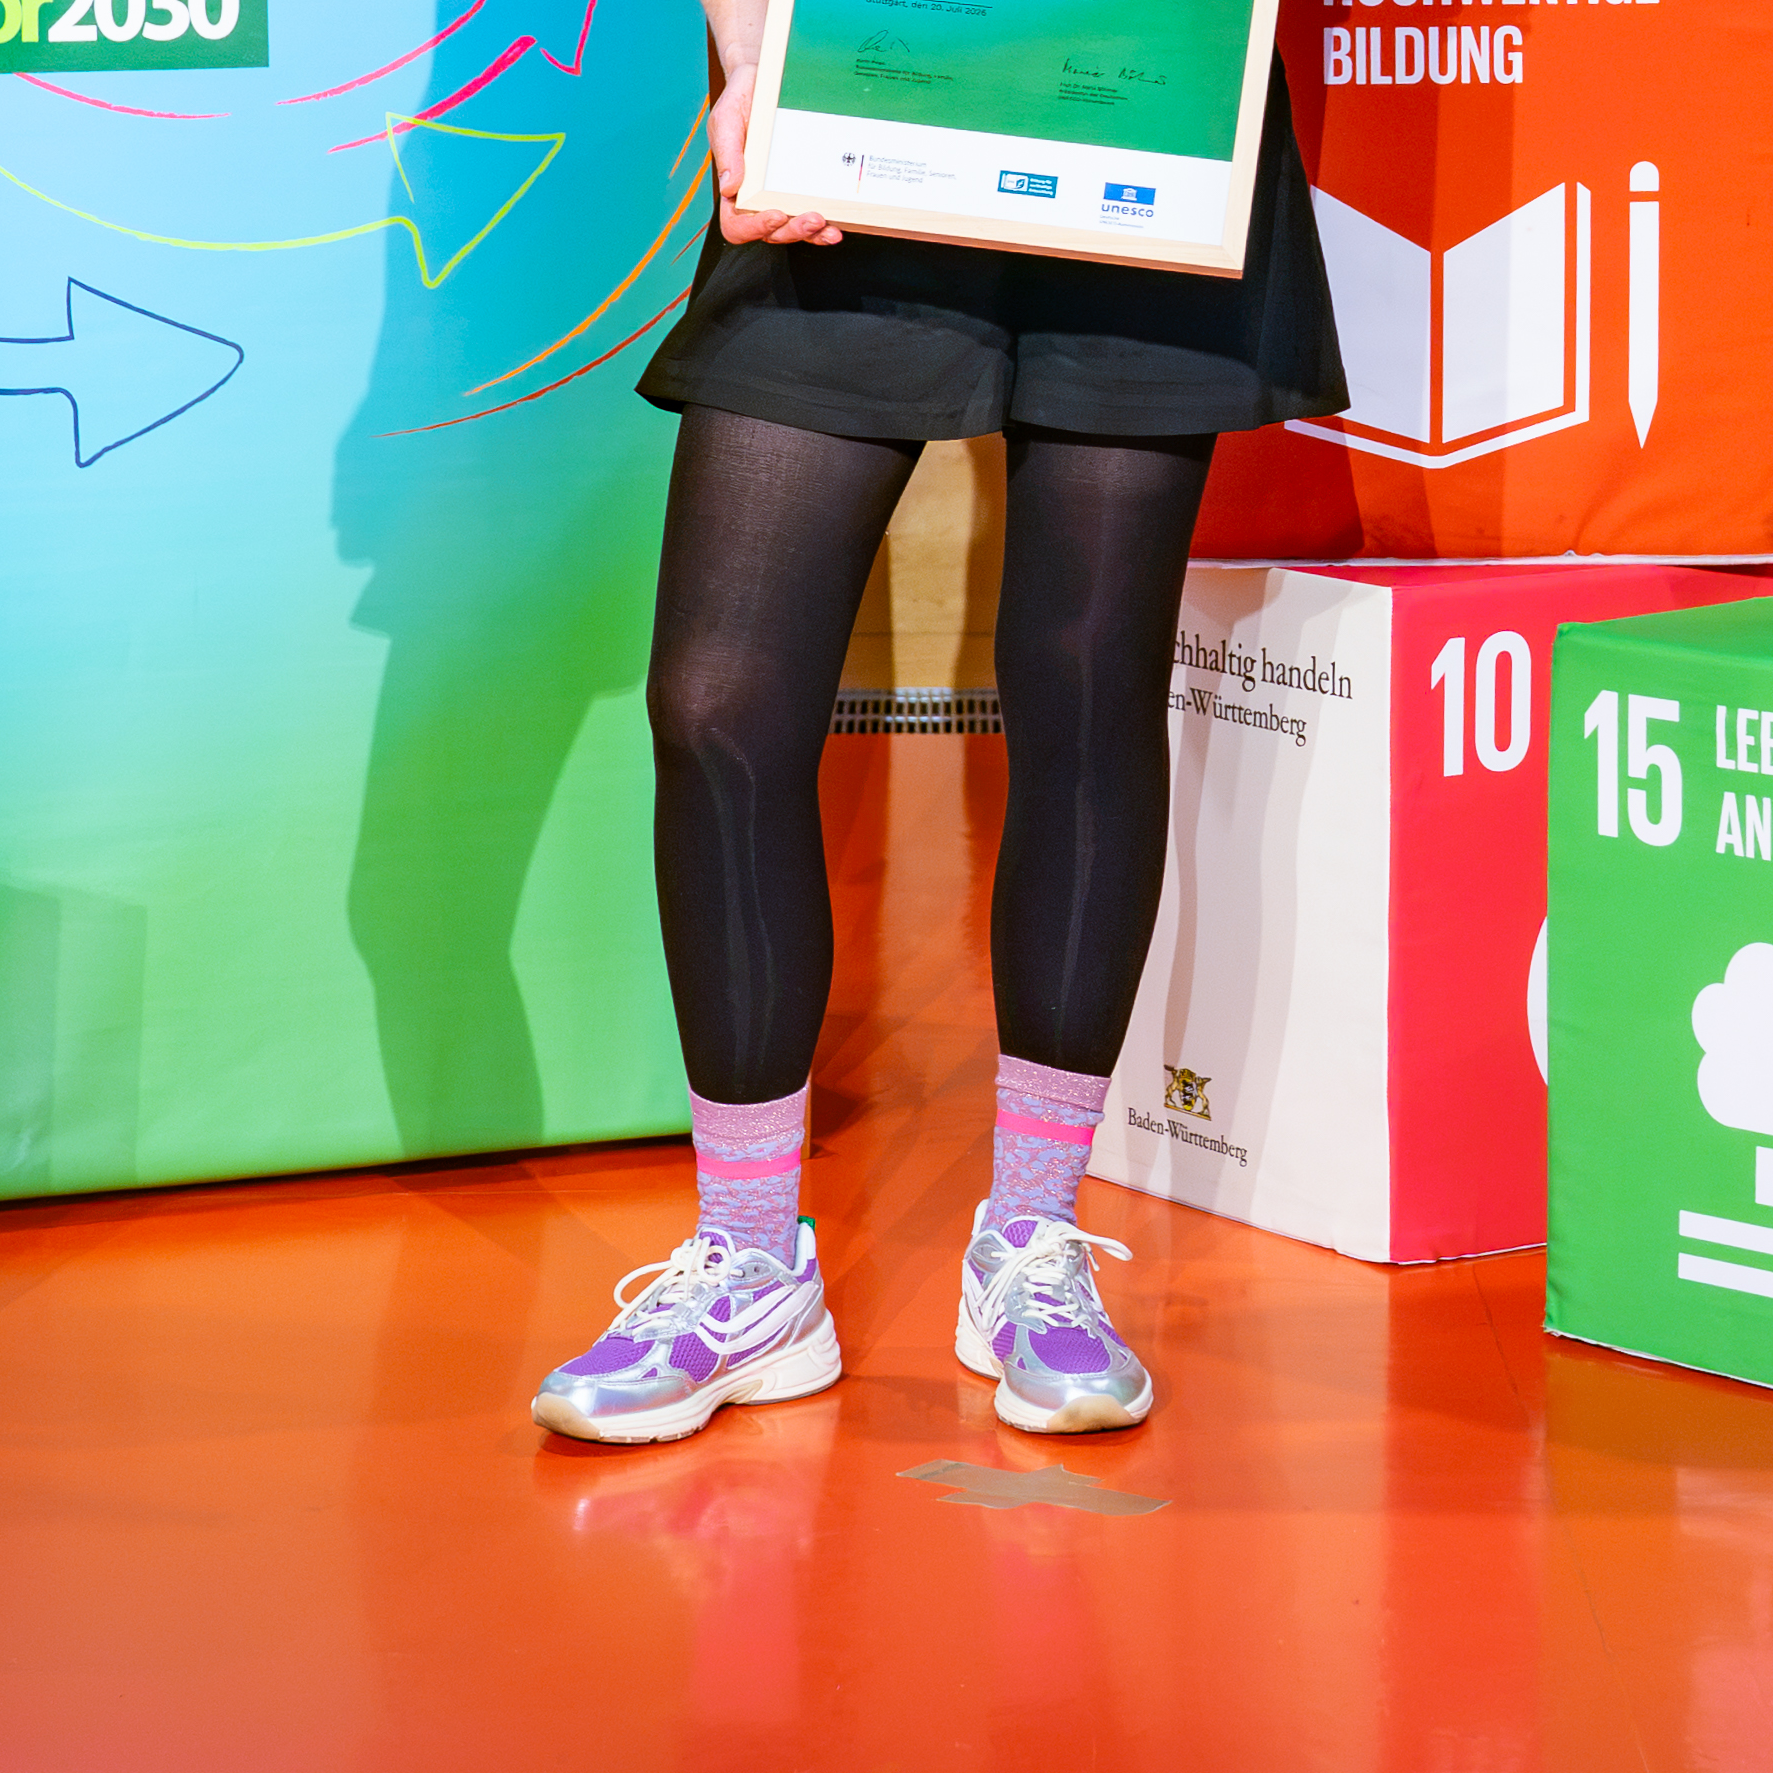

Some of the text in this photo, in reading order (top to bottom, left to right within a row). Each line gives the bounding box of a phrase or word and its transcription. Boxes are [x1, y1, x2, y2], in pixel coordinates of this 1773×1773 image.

[911, 0, 928, 9] den
[945, 5, 963, 13] Juli
[964, 7, 987, 17] 2026
[1323, 25, 1524, 86] BILDUNG
[1101, 203, 1154, 218] unesco
[1260, 647, 1353, 700] handeln
[1430, 630, 1532, 777] 10
[1584, 689, 1683, 847] 15
[1715, 791, 1772, 861] AN
[1127, 1106, 1248, 1167] Baden-Württemberg
